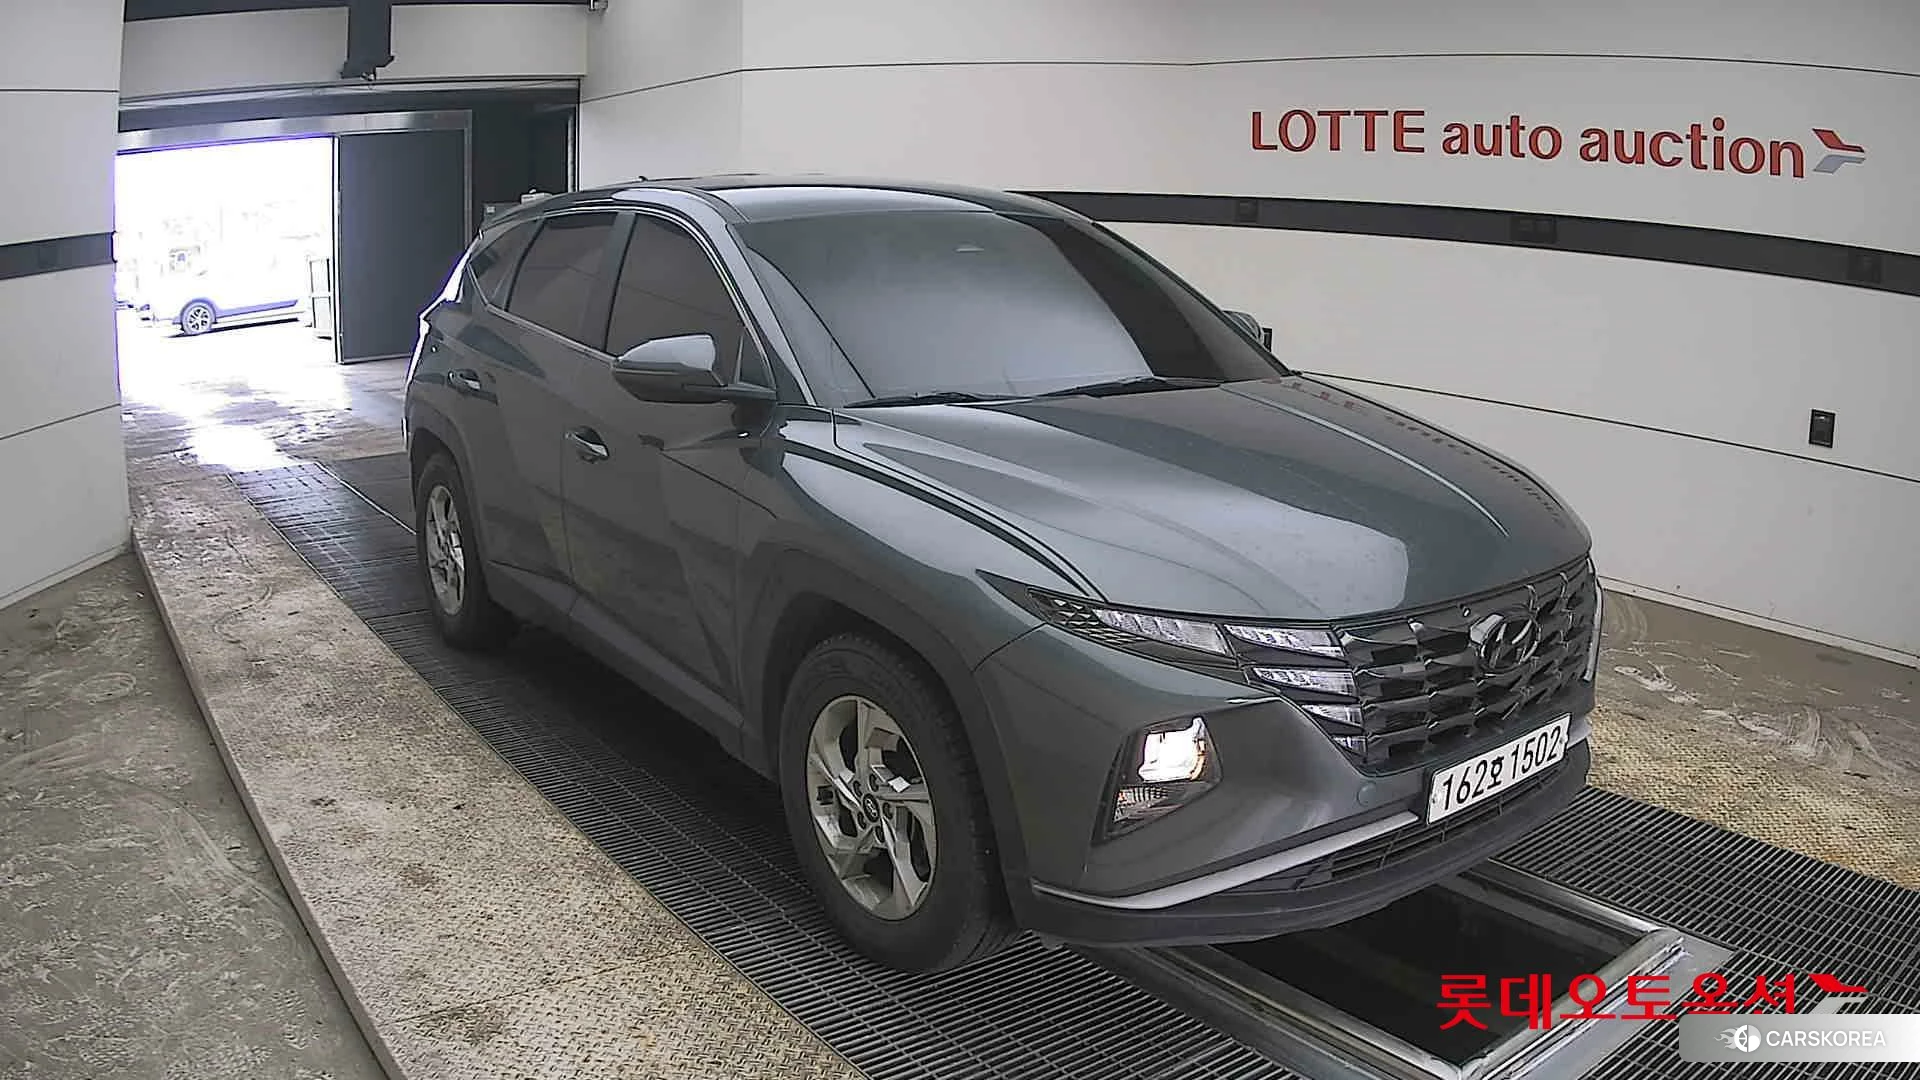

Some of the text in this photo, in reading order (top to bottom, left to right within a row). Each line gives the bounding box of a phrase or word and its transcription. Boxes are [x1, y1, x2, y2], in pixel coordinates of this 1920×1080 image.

[1251, 110, 1805, 179] LOTTE auto auction
